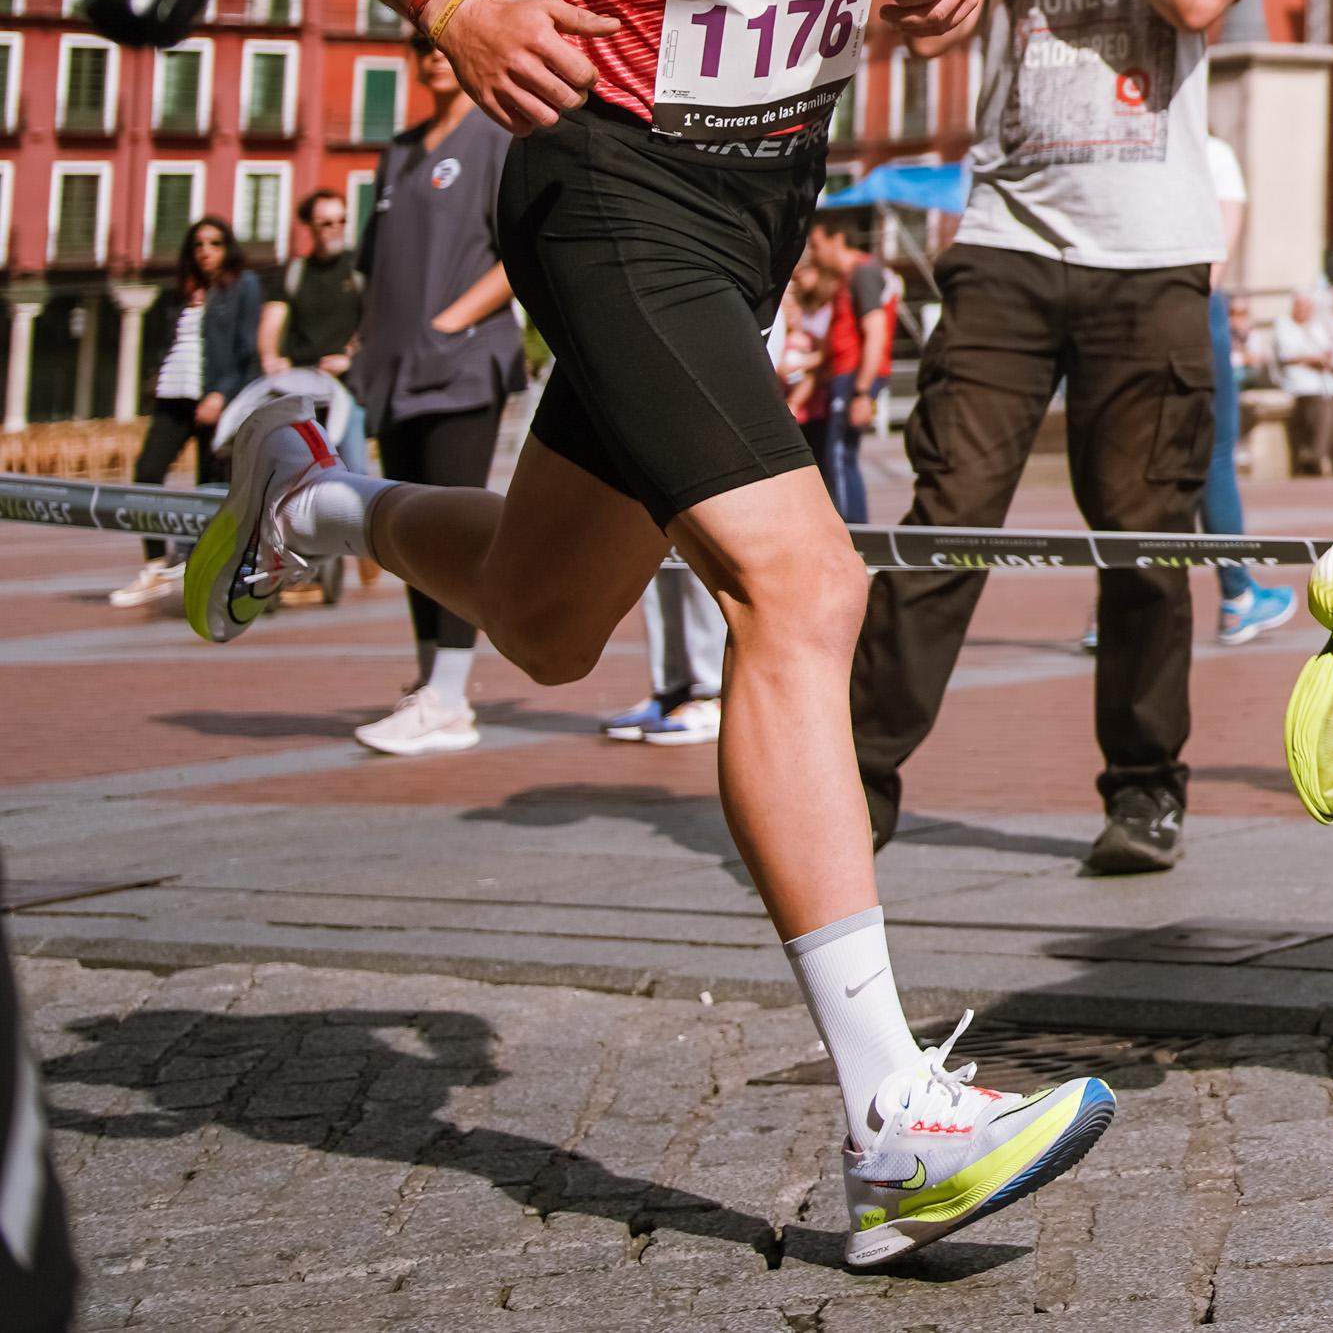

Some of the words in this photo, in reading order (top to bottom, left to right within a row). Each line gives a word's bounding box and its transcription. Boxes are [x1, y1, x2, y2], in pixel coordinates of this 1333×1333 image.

[704, 115, 758, 128] Carrera
[762, 110, 776, 124] de
[779, 104, 794, 119] las
